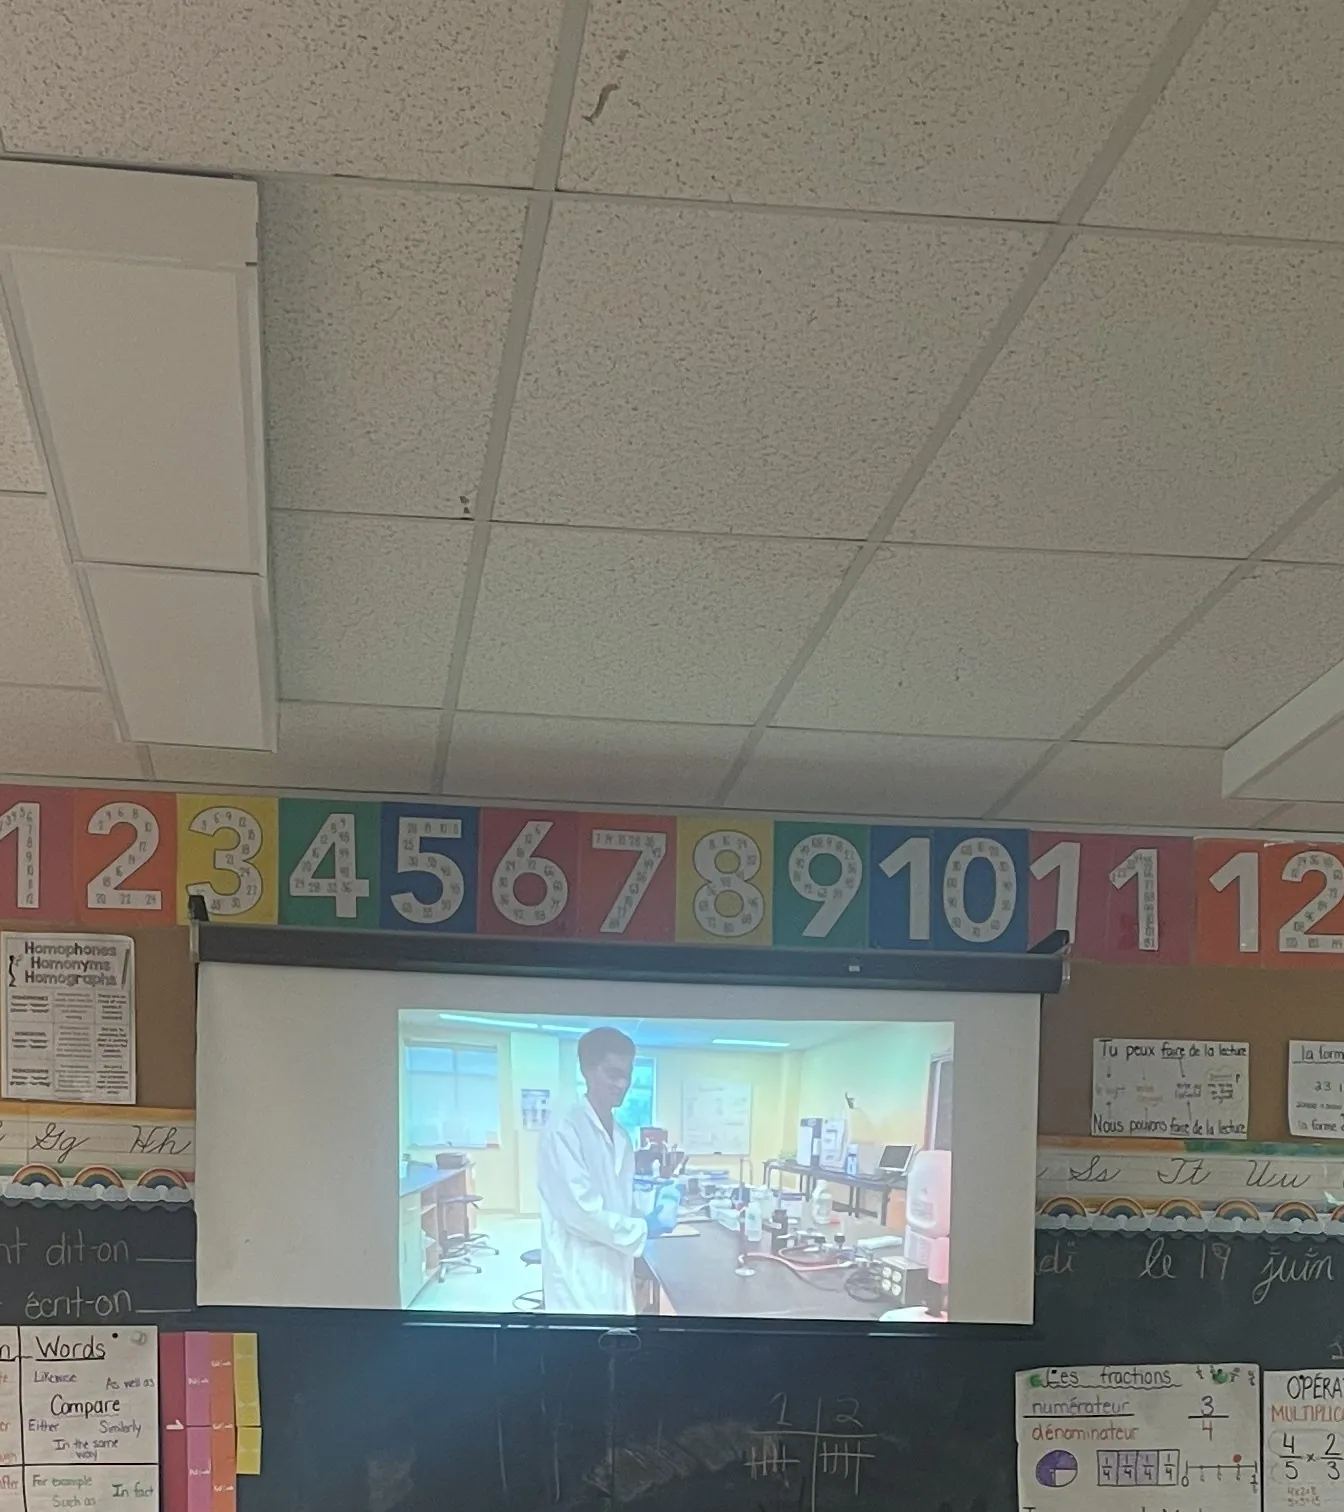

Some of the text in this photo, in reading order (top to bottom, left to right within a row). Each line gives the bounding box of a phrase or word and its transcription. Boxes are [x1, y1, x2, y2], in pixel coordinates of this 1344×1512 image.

[88, 802, 162, 910] 2
[187, 806, 264, 916] 3
[289, 813, 370, 918] 4
[390, 817, 465, 924] 5
[491, 820, 569, 927] 6
[879, 836, 1018, 942] 10
[1029, 841, 1158, 951] 11
[24, 941, 118, 958] Homophones
[30, 956, 112, 974] Homonyms
[24, 971, 118, 988] Homographs
[1099, 1039, 1156, 1059] Tu peux
[1093, 1113, 1125, 1135] Nous
[1253, 1246, 1335, 1304] juin
[35, 1334, 106, 1360] Words
[1099, 1366, 1173, 1386] fractions
[50, 1394, 121, 1420] Compare
[1031, 1396, 1130, 1416] numérateur
[1031, 1423, 1140, 1442] dénominateur
